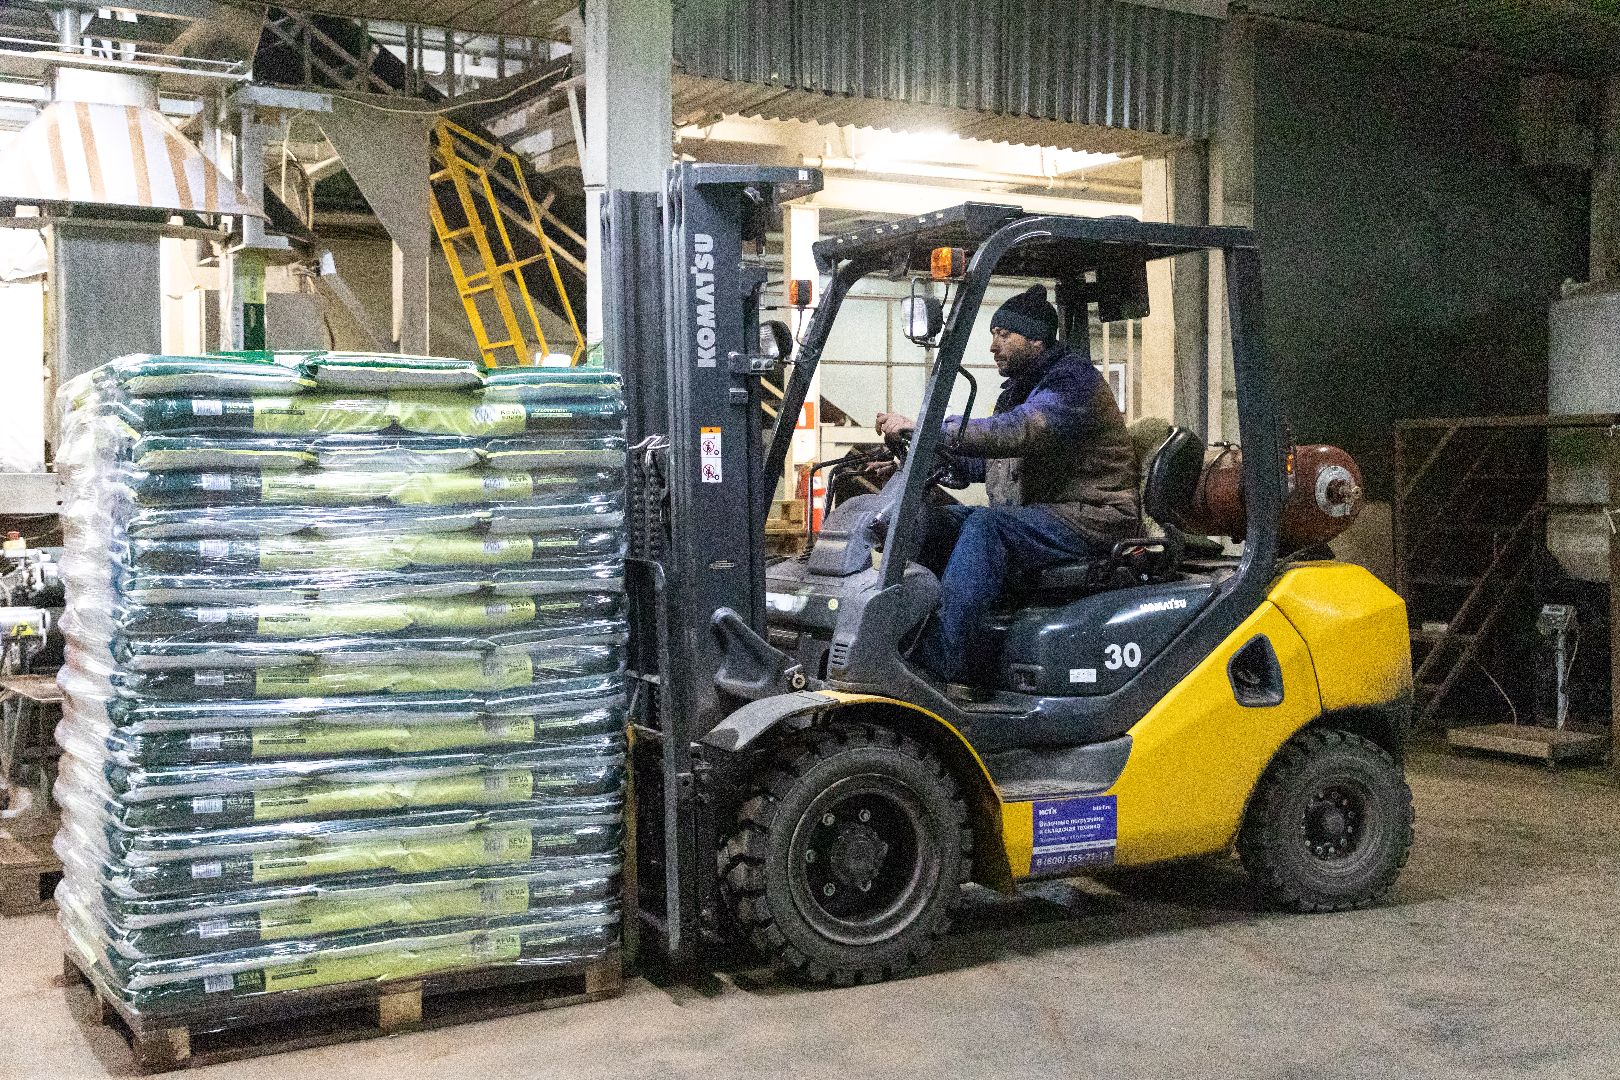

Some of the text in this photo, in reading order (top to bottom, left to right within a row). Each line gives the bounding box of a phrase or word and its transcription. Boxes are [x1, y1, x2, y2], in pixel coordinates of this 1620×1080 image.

[690, 233, 717, 368] KOMATSU
[1139, 598, 1187, 612] KOMATSU
[1104, 642, 1142, 670] 30
